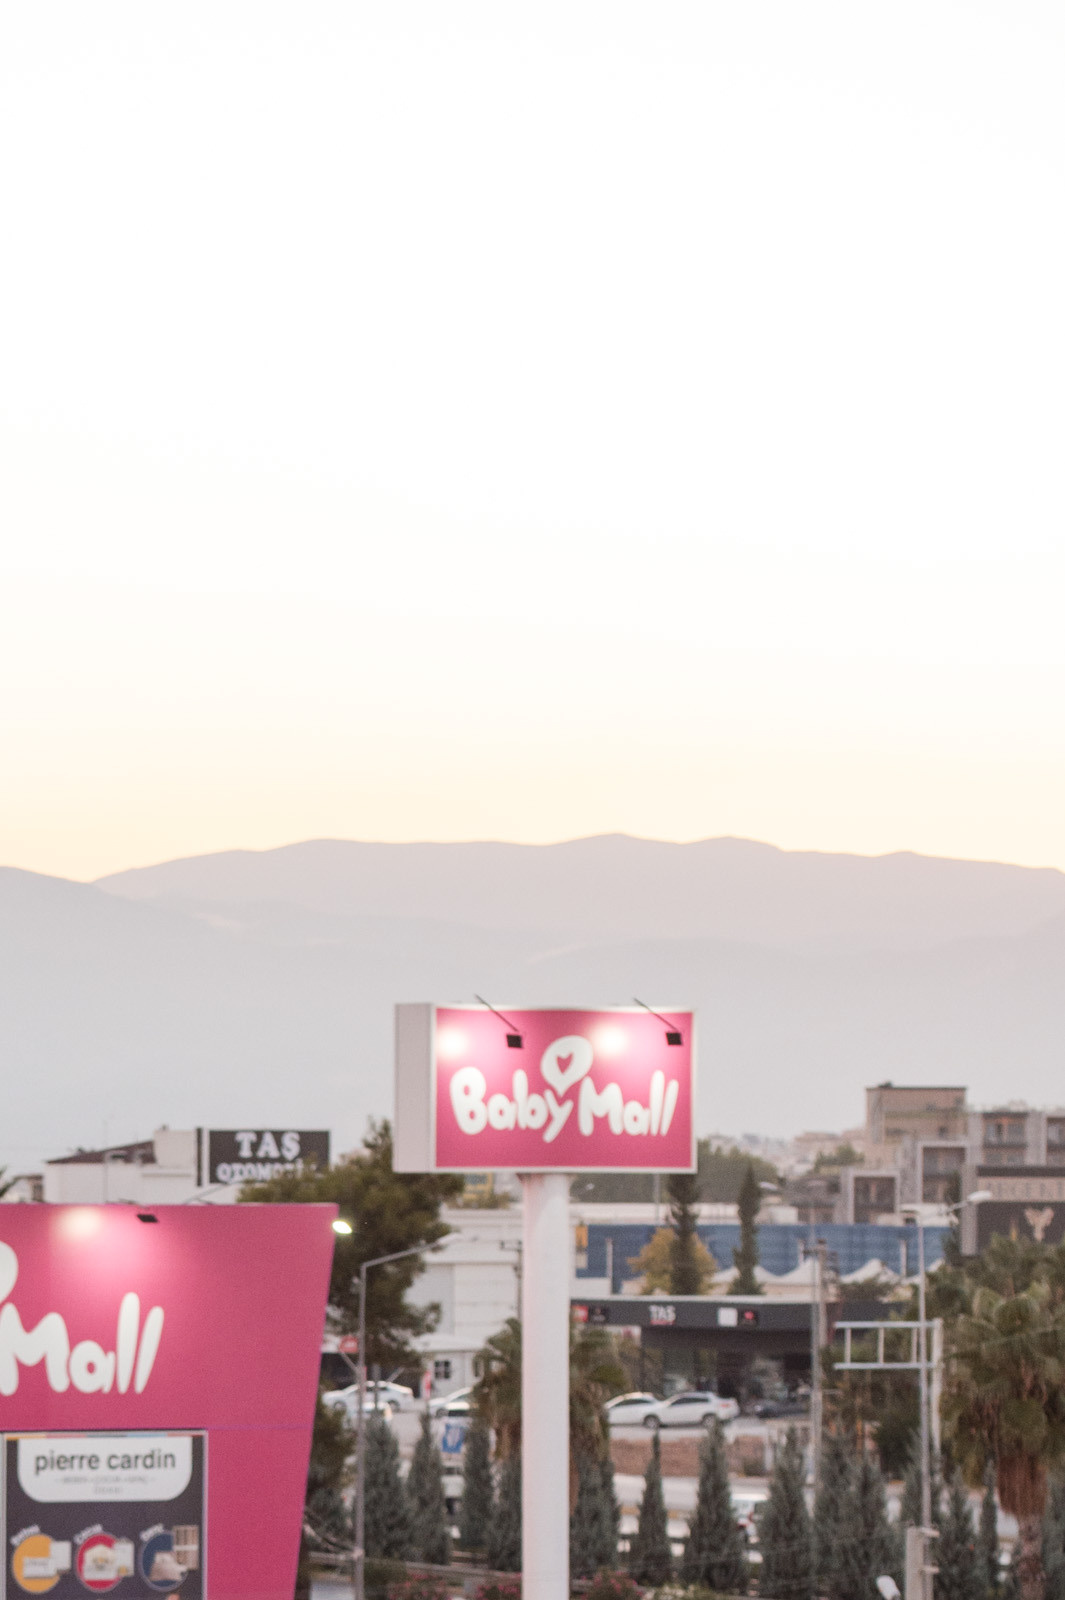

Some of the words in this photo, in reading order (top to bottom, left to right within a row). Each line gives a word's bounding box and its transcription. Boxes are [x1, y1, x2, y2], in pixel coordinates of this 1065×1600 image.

[449, 1066, 574, 1143] Baby
[578, 1069, 679, 1136] Mall
[34, 1450, 100, 1475] pierre
[107, 1449, 176, 1470] cardin
